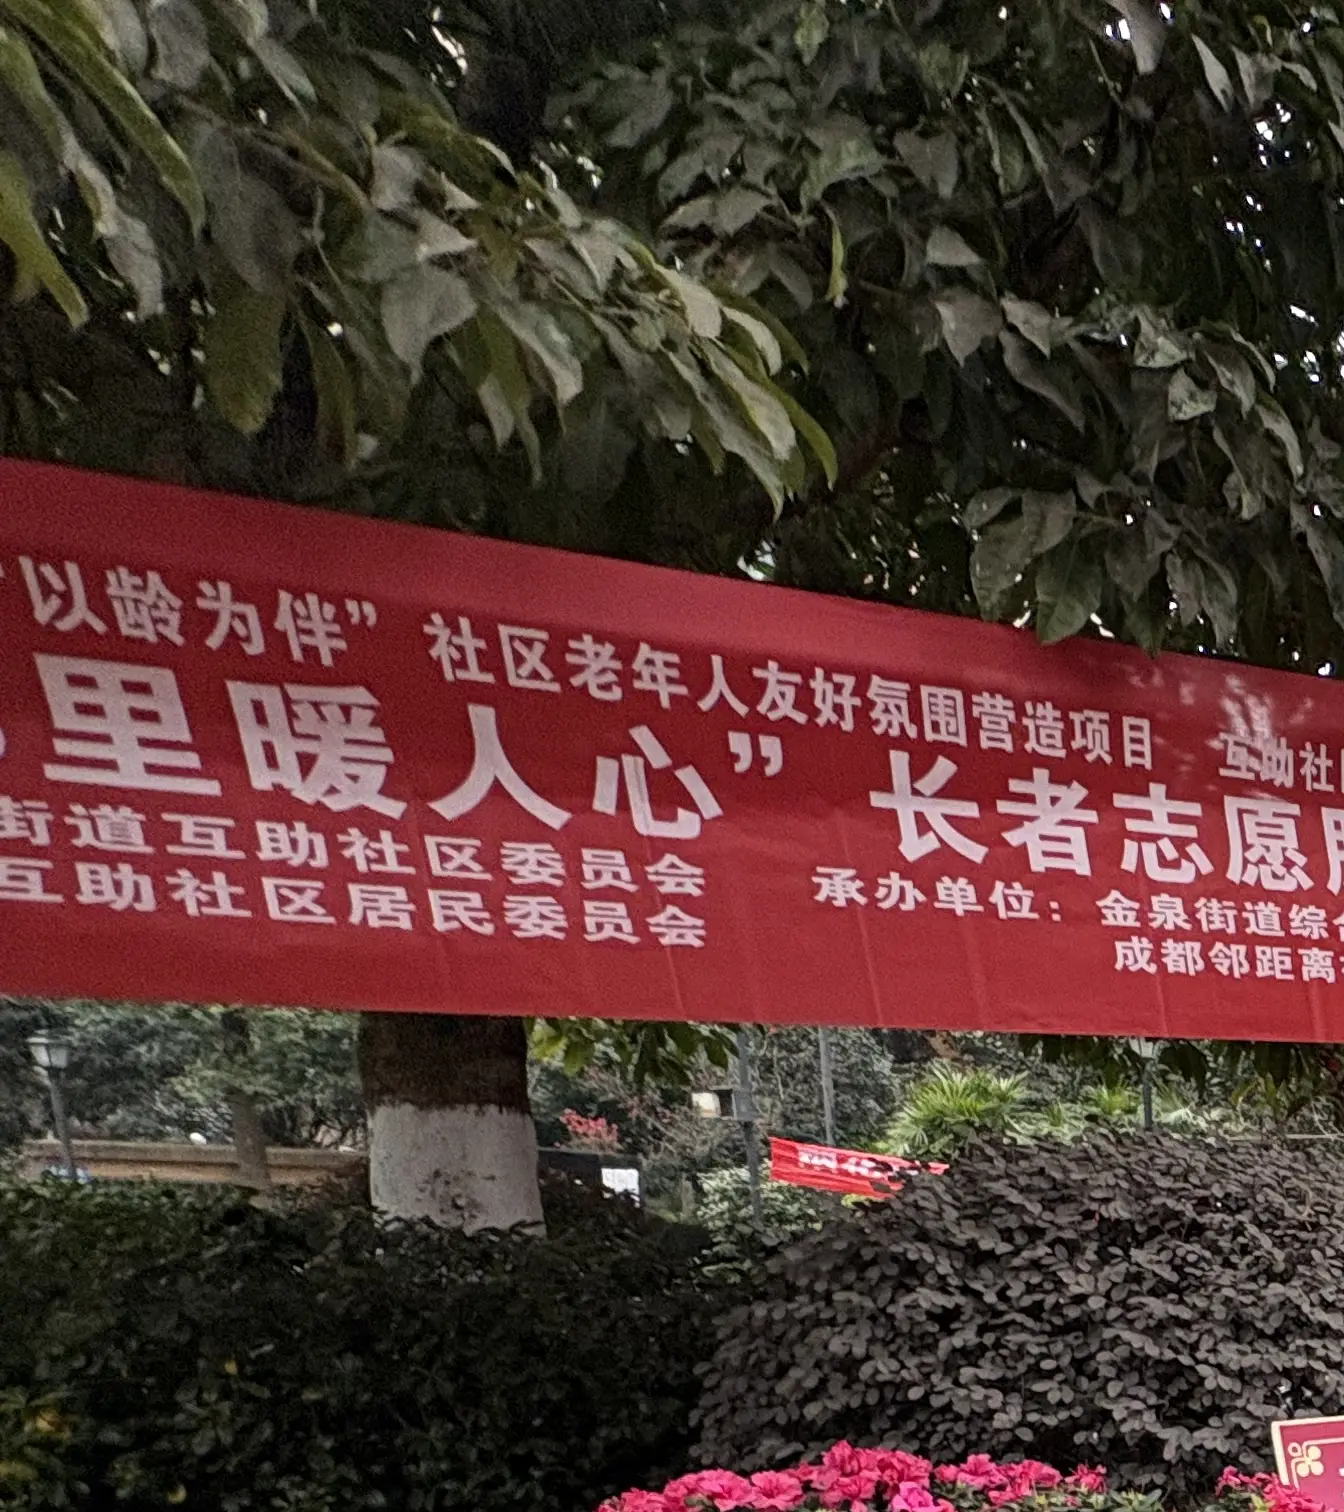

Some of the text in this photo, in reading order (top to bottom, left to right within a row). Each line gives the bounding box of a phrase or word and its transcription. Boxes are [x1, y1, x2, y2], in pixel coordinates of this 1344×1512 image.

[0, 556, 379, 667] 以龄为伴”
[423, 611, 1153, 772] 社区老年人友好氛围营造项目
[0, 652, 784, 841] 里暖人心”
[0, 856, 706, 948] 互助社区居民委员会
